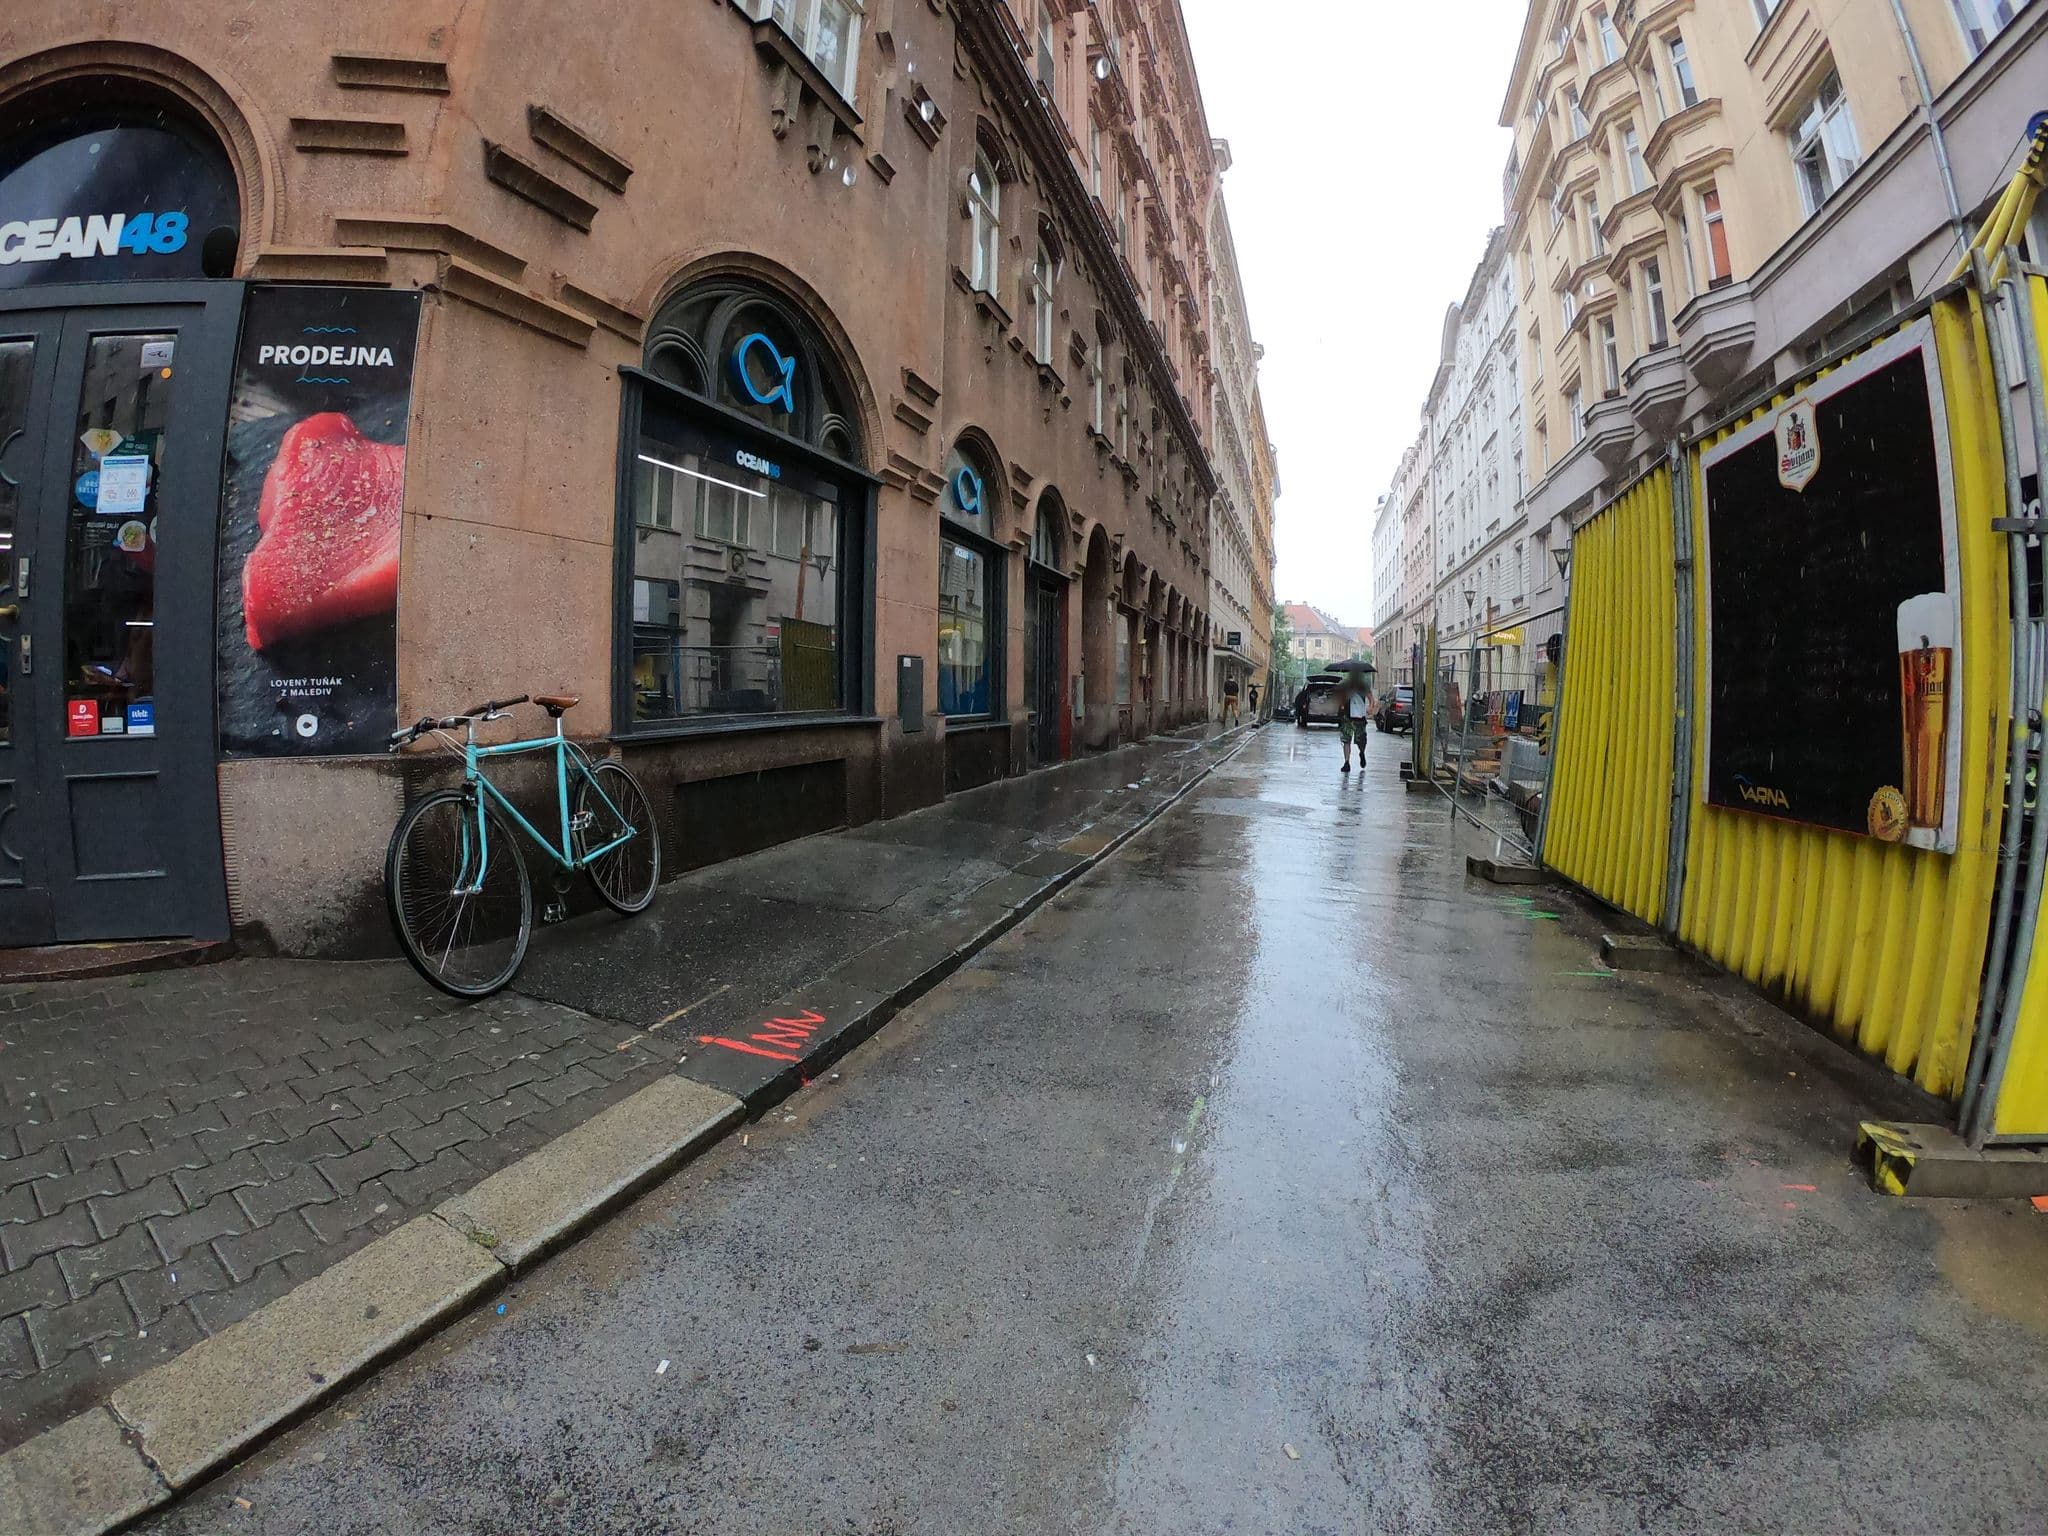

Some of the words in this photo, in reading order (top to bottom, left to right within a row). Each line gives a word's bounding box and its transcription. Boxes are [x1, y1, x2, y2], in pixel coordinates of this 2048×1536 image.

[258, 345, 394, 367] PRODEJNA
[270, 677, 307, 688] LOVENÝ
[311, 676, 342, 686] TUŇÁK
[281, 689, 287, 697] Z
[290, 688, 332, 697] MALEDIV
[1739, 784, 1790, 809] VARNA
